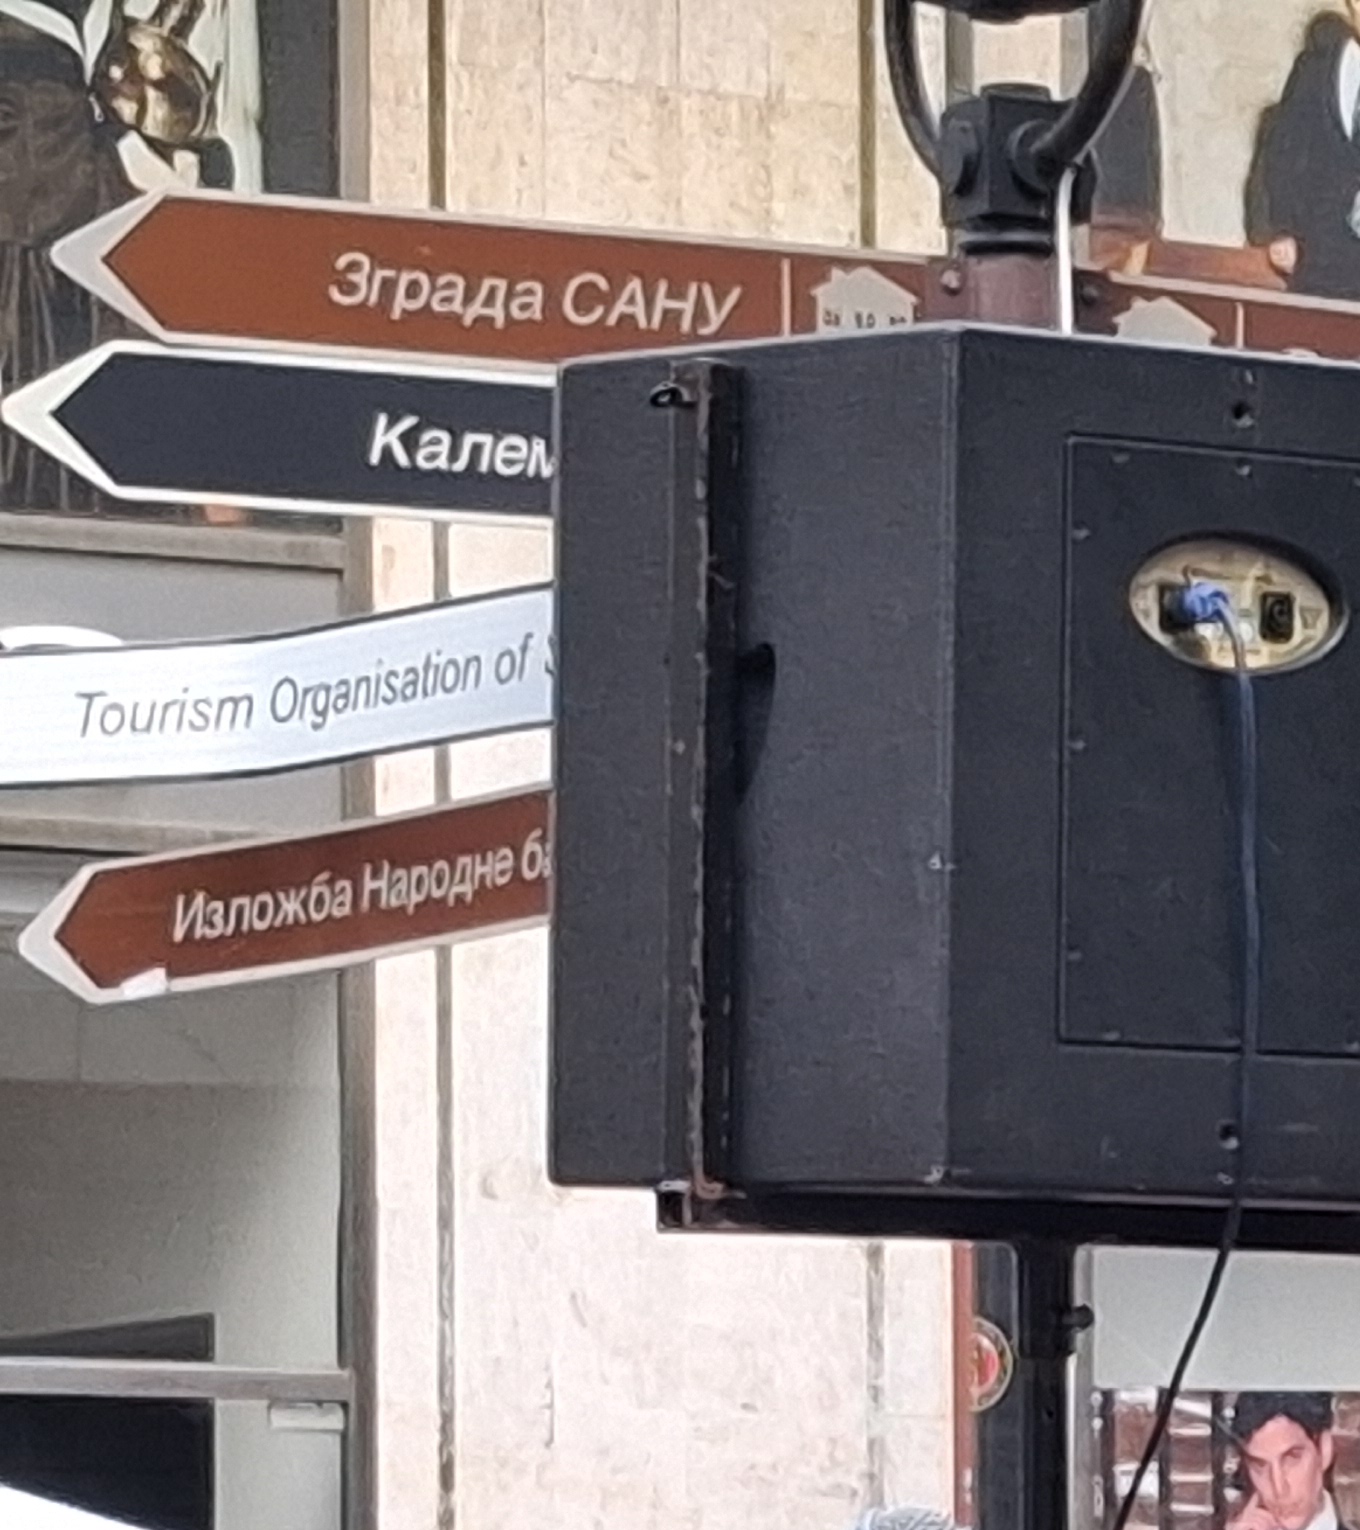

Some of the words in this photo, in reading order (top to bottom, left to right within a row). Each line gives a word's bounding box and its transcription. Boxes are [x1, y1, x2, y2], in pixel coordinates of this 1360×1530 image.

[328, 252, 544, 329] Зграда
[562, 272, 742, 336] САНУ
[75, 686, 254, 738] Tourism
[270, 647, 483, 731] Organisation
[495, 633, 534, 682] of
[173, 876, 353, 943] Изложба
[362, 846, 512, 915] Народне
